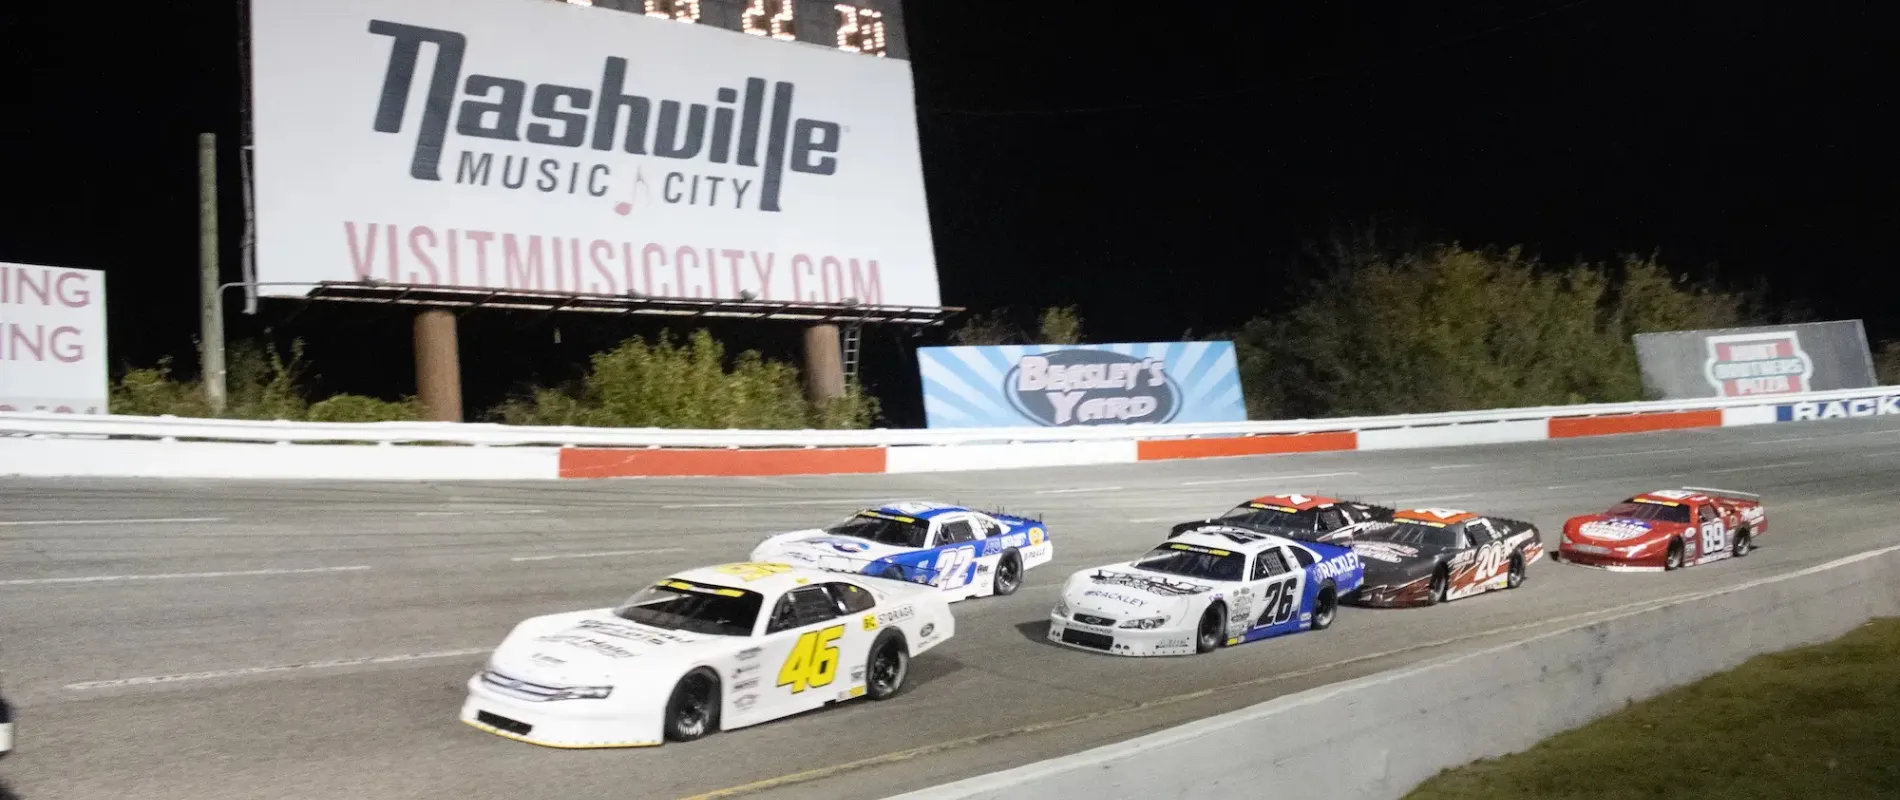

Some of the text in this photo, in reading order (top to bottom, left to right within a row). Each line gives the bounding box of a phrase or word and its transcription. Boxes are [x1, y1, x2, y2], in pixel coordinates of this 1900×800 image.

[456, 151, 752, 210] MUSIC CITY
[0, 267, 91, 308] ING
[1702, 518, 1726, 555] 89
[935, 545, 975, 592] 22
[1321, 550, 1359, 579] RACKLEY
[1474, 541, 1503, 581] 20
[1091, 590, 1149, 608] RACKLEY
[1254, 577, 1298, 629] 26
[776, 623, 845, 694] 46
